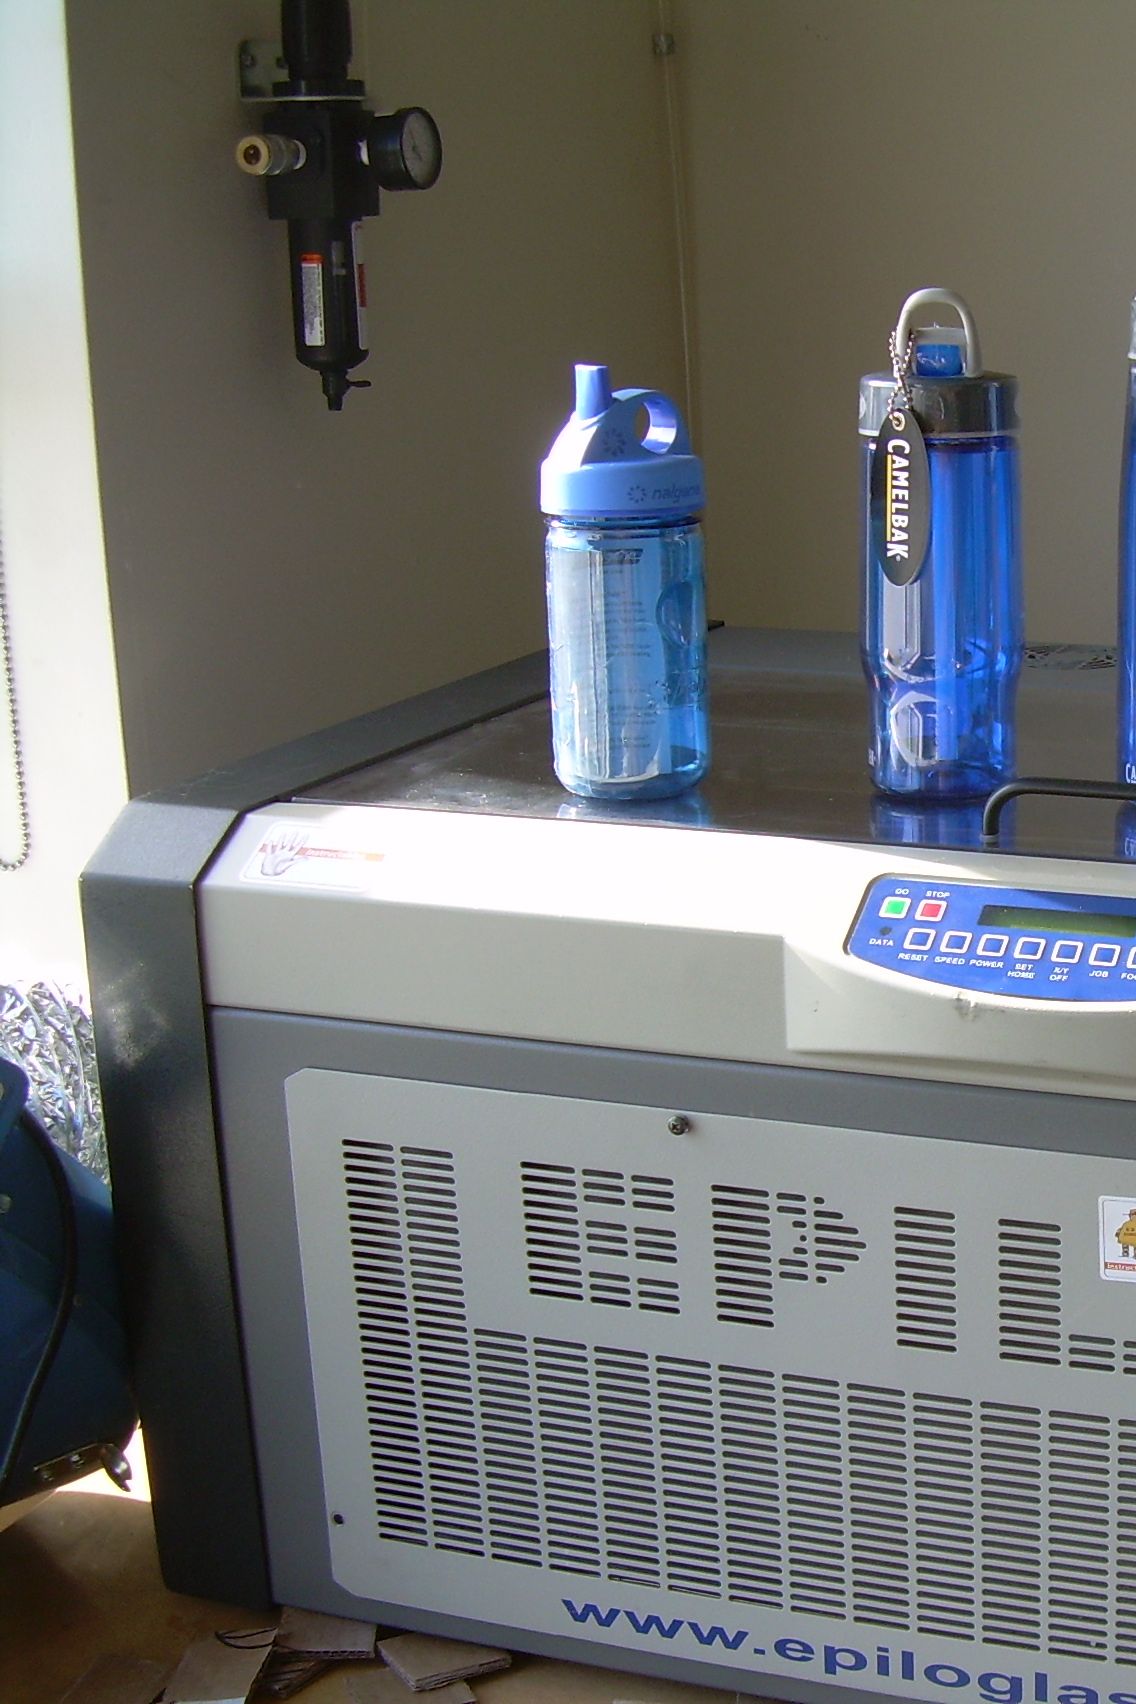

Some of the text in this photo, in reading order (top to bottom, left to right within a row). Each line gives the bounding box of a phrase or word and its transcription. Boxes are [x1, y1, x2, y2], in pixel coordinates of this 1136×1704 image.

[886, 438, 911, 560] CAMELBAK
[894, 887, 910, 895] GO
[925, 890, 951, 898] STOP
[868, 938, 895, 947] DATA
[897, 953, 929, 962] RESET
[934, 955, 966, 965] SPEED
[969, 958, 1005, 969] POWER
[1007, 970, 1036, 979] HOME
[1048, 974, 1069, 982] OFF
[1088, 970, 1109, 978] JOB
